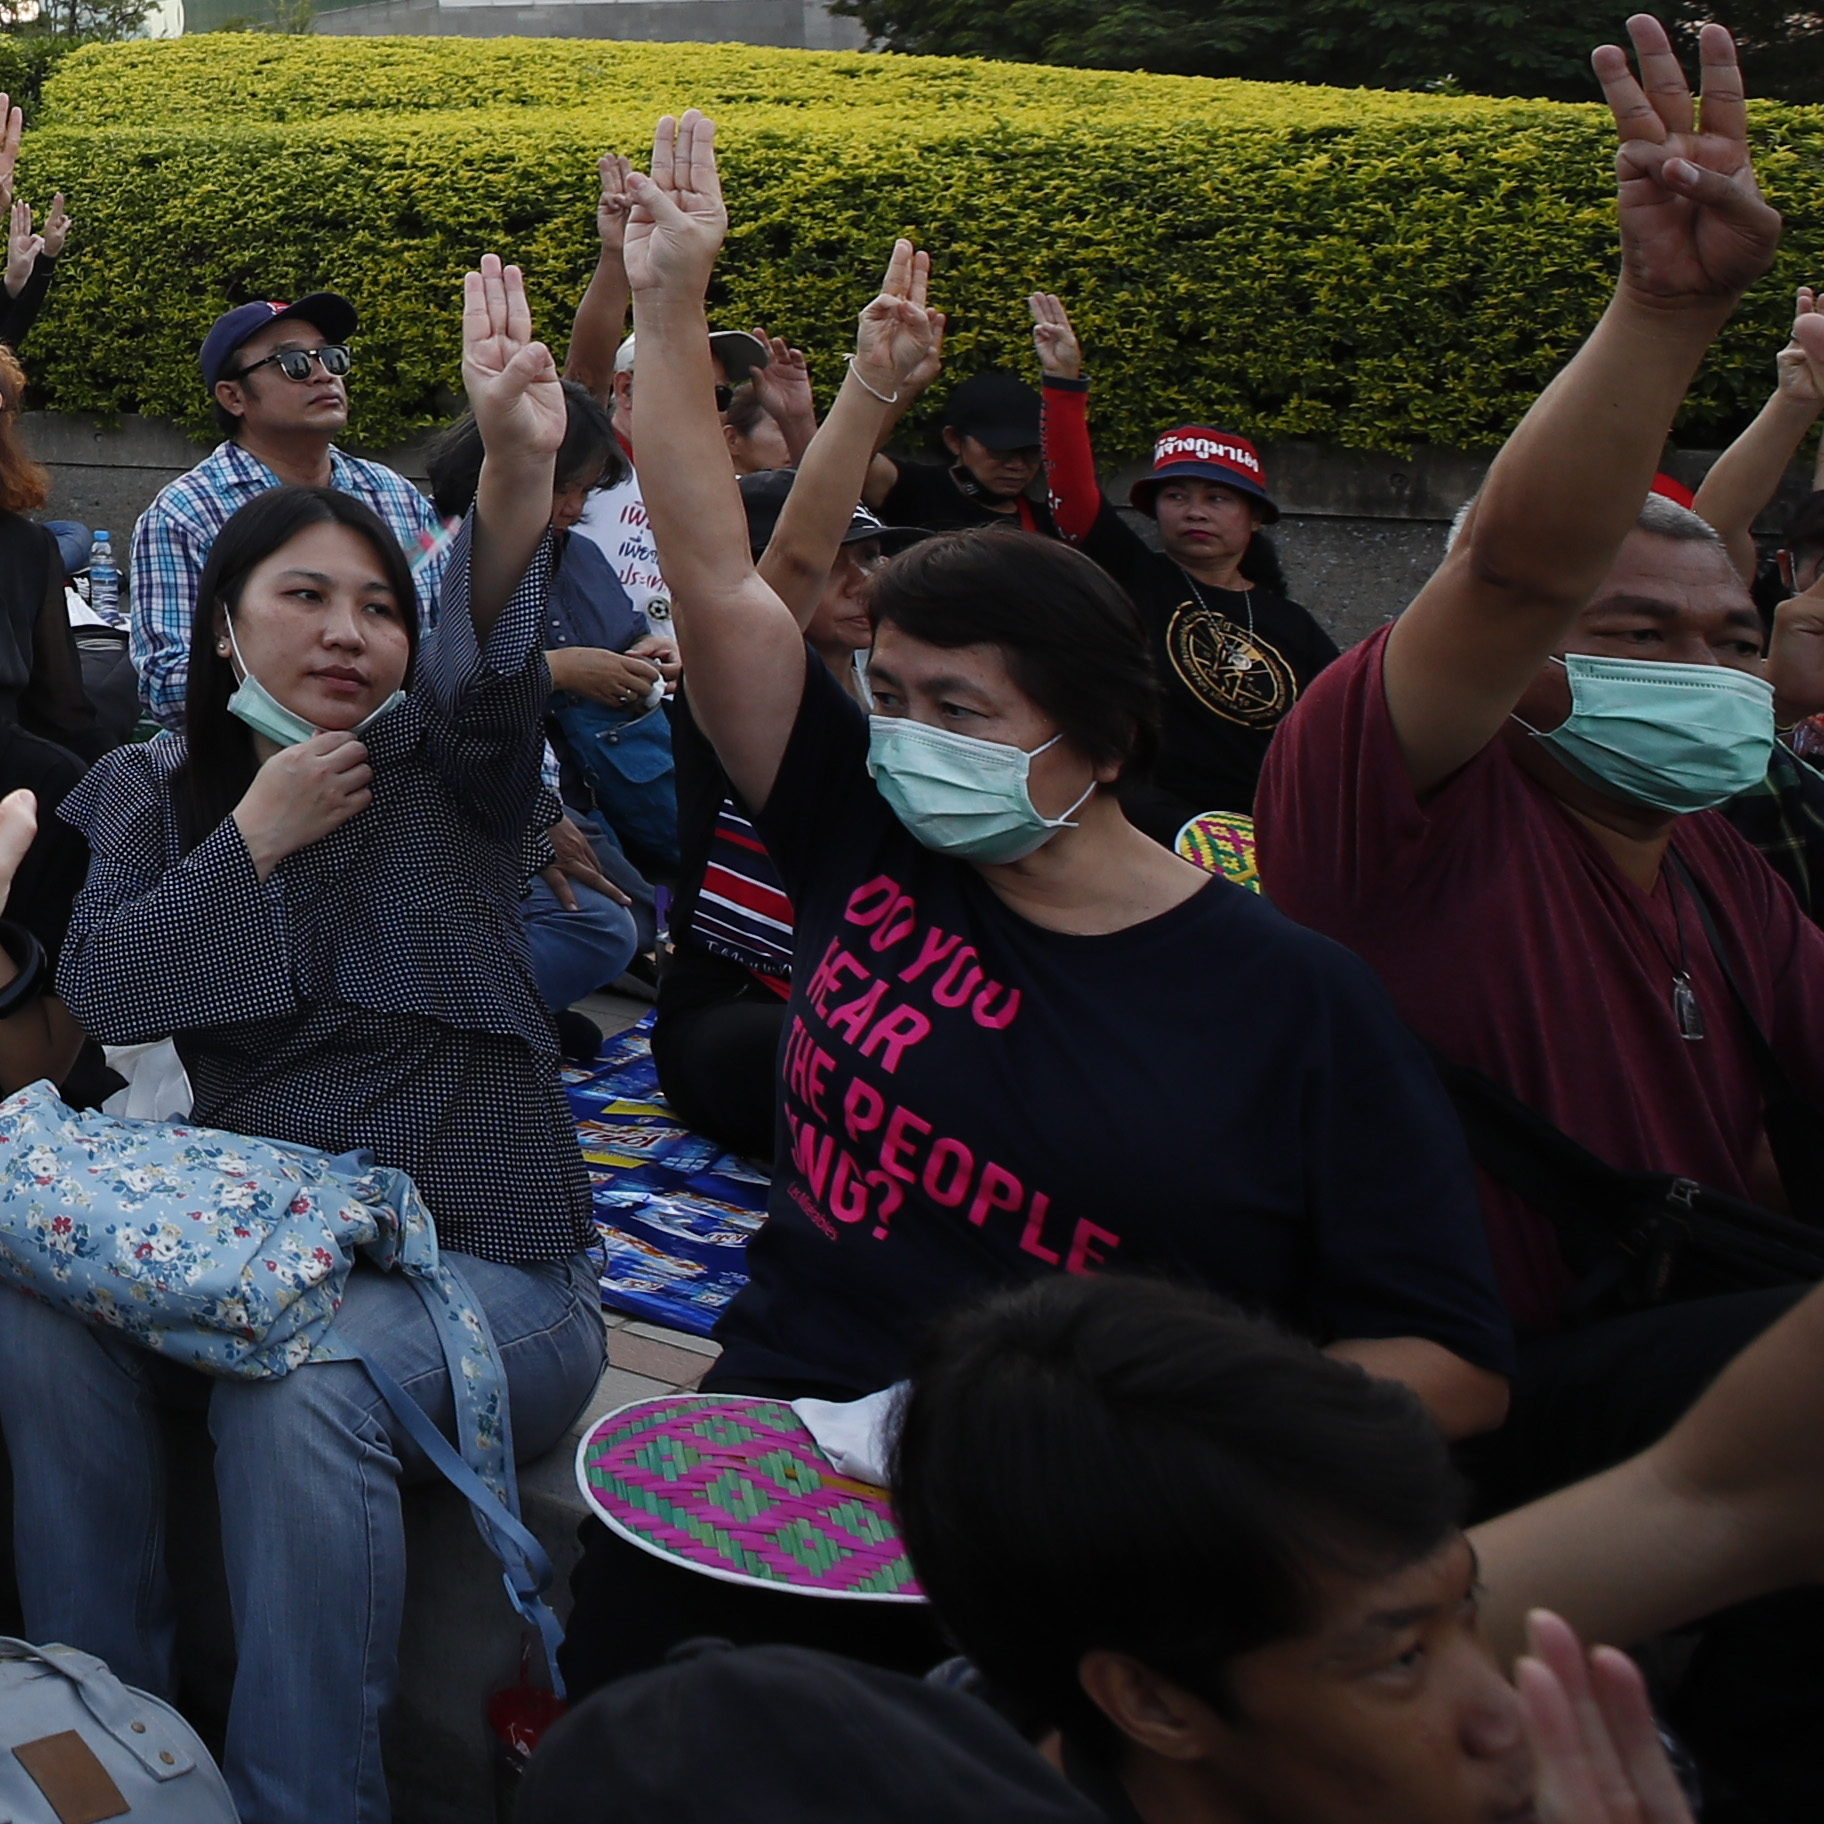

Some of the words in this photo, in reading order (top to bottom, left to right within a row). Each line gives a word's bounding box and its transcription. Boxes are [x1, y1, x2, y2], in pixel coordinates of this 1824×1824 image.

[805, 935, 932, 1075] HEAR
[844, 873, 917, 953] DO
[896, 925, 1022, 1031] YOU
[782, 1014, 837, 1124] THE
[843, 1075, 1122, 1279] PEOPLE
